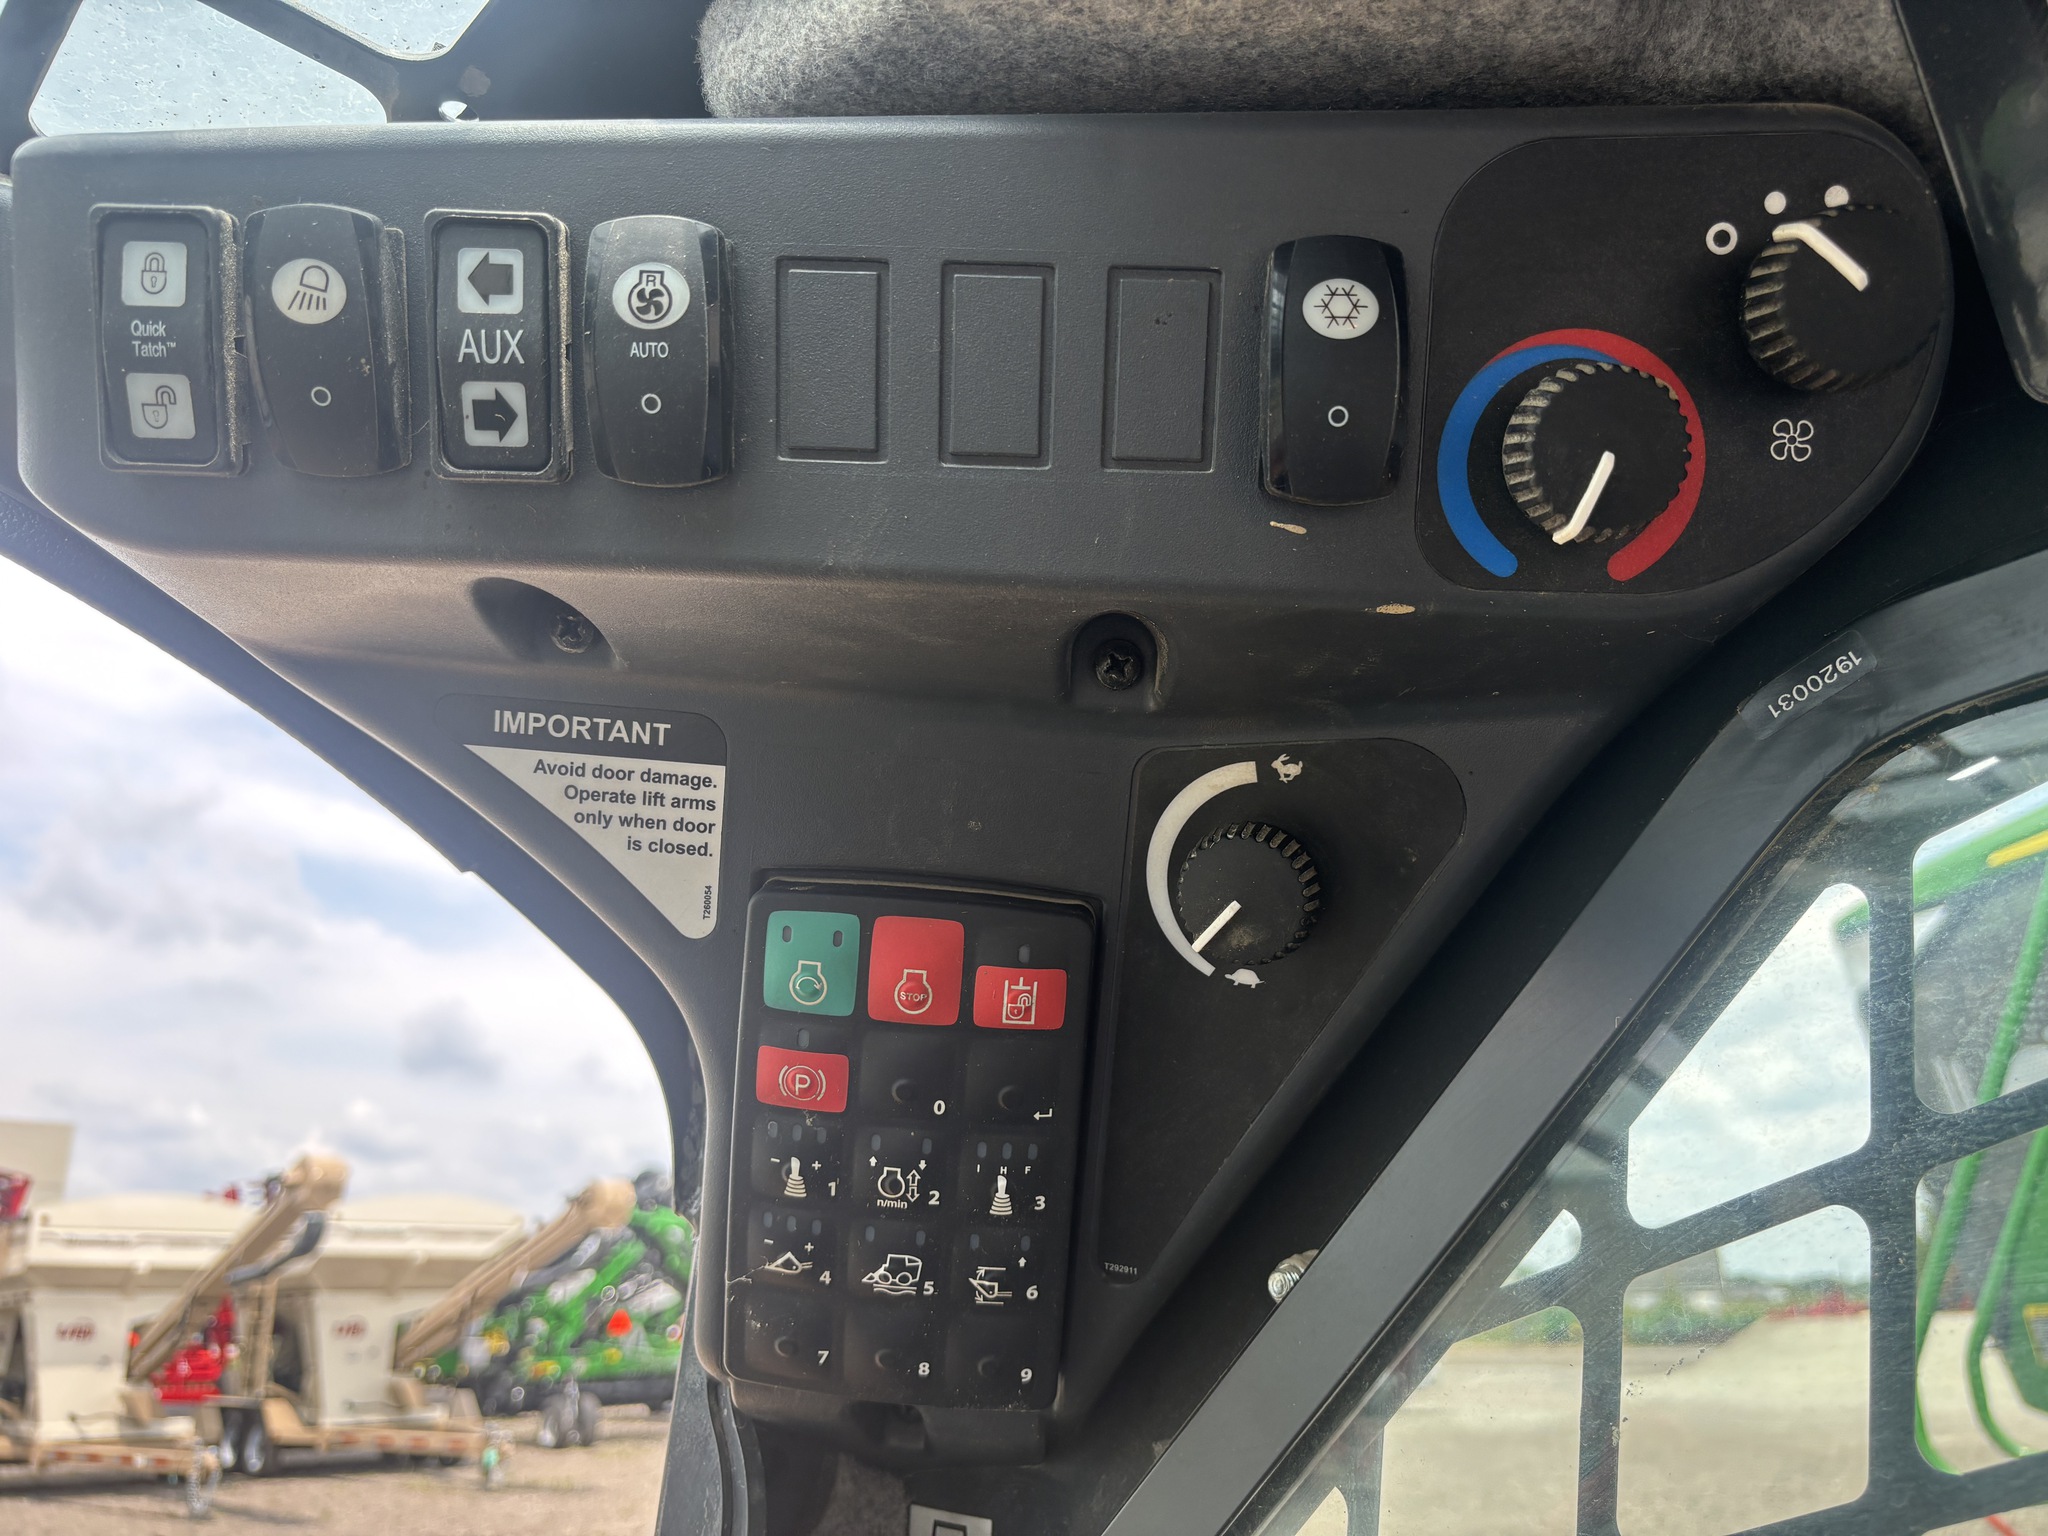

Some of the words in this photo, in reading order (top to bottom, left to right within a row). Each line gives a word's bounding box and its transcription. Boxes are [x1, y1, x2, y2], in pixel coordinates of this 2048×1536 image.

[130, 319, 167, 337] Quick
[458, 328, 525, 364] AUX
[630, 341, 669, 358] AUTO
[1767, 650, 1863, 719] 1920031
[493, 709, 671, 747] IMPORTANT
[532, 758, 586, 779] Avoid
[591, 763, 635, 782] door
[640, 768, 718, 791] damage.
[564, 784, 636, 805] Operate
[642, 790, 666, 808] lift
[670, 797, 716, 812] arms
[573, 810, 613, 830] only
[618, 813, 667, 831] when
[672, 817, 716, 835] door
[627, 836, 642, 852] is
[648, 838, 713, 858] closed.
[702, 885, 713, 921] T260054
[900, 991, 928, 1003] STOP
[795, 1074, 811, 1096] P
[932, 1099, 946, 1115] 0
[1000, 1165, 1008, 1175] H
[1024, 1165, 1032, 1175] F
[827, 1181, 837, 1197] 1
[876, 1198, 909, 1210] n/min
[927, 1190, 940, 1206] 2
[1033, 1195, 1046, 1211] 3
[1103, 1261, 1138, 1276] T292911
[819, 1270, 832, 1285] 4
[922, 1280, 935, 1296] 5
[1026, 1285, 1039, 1300] 6
[817, 1350, 830, 1366] 7
[917, 1362, 930, 1377] 8
[1020, 1368, 1033, 1384] 9
